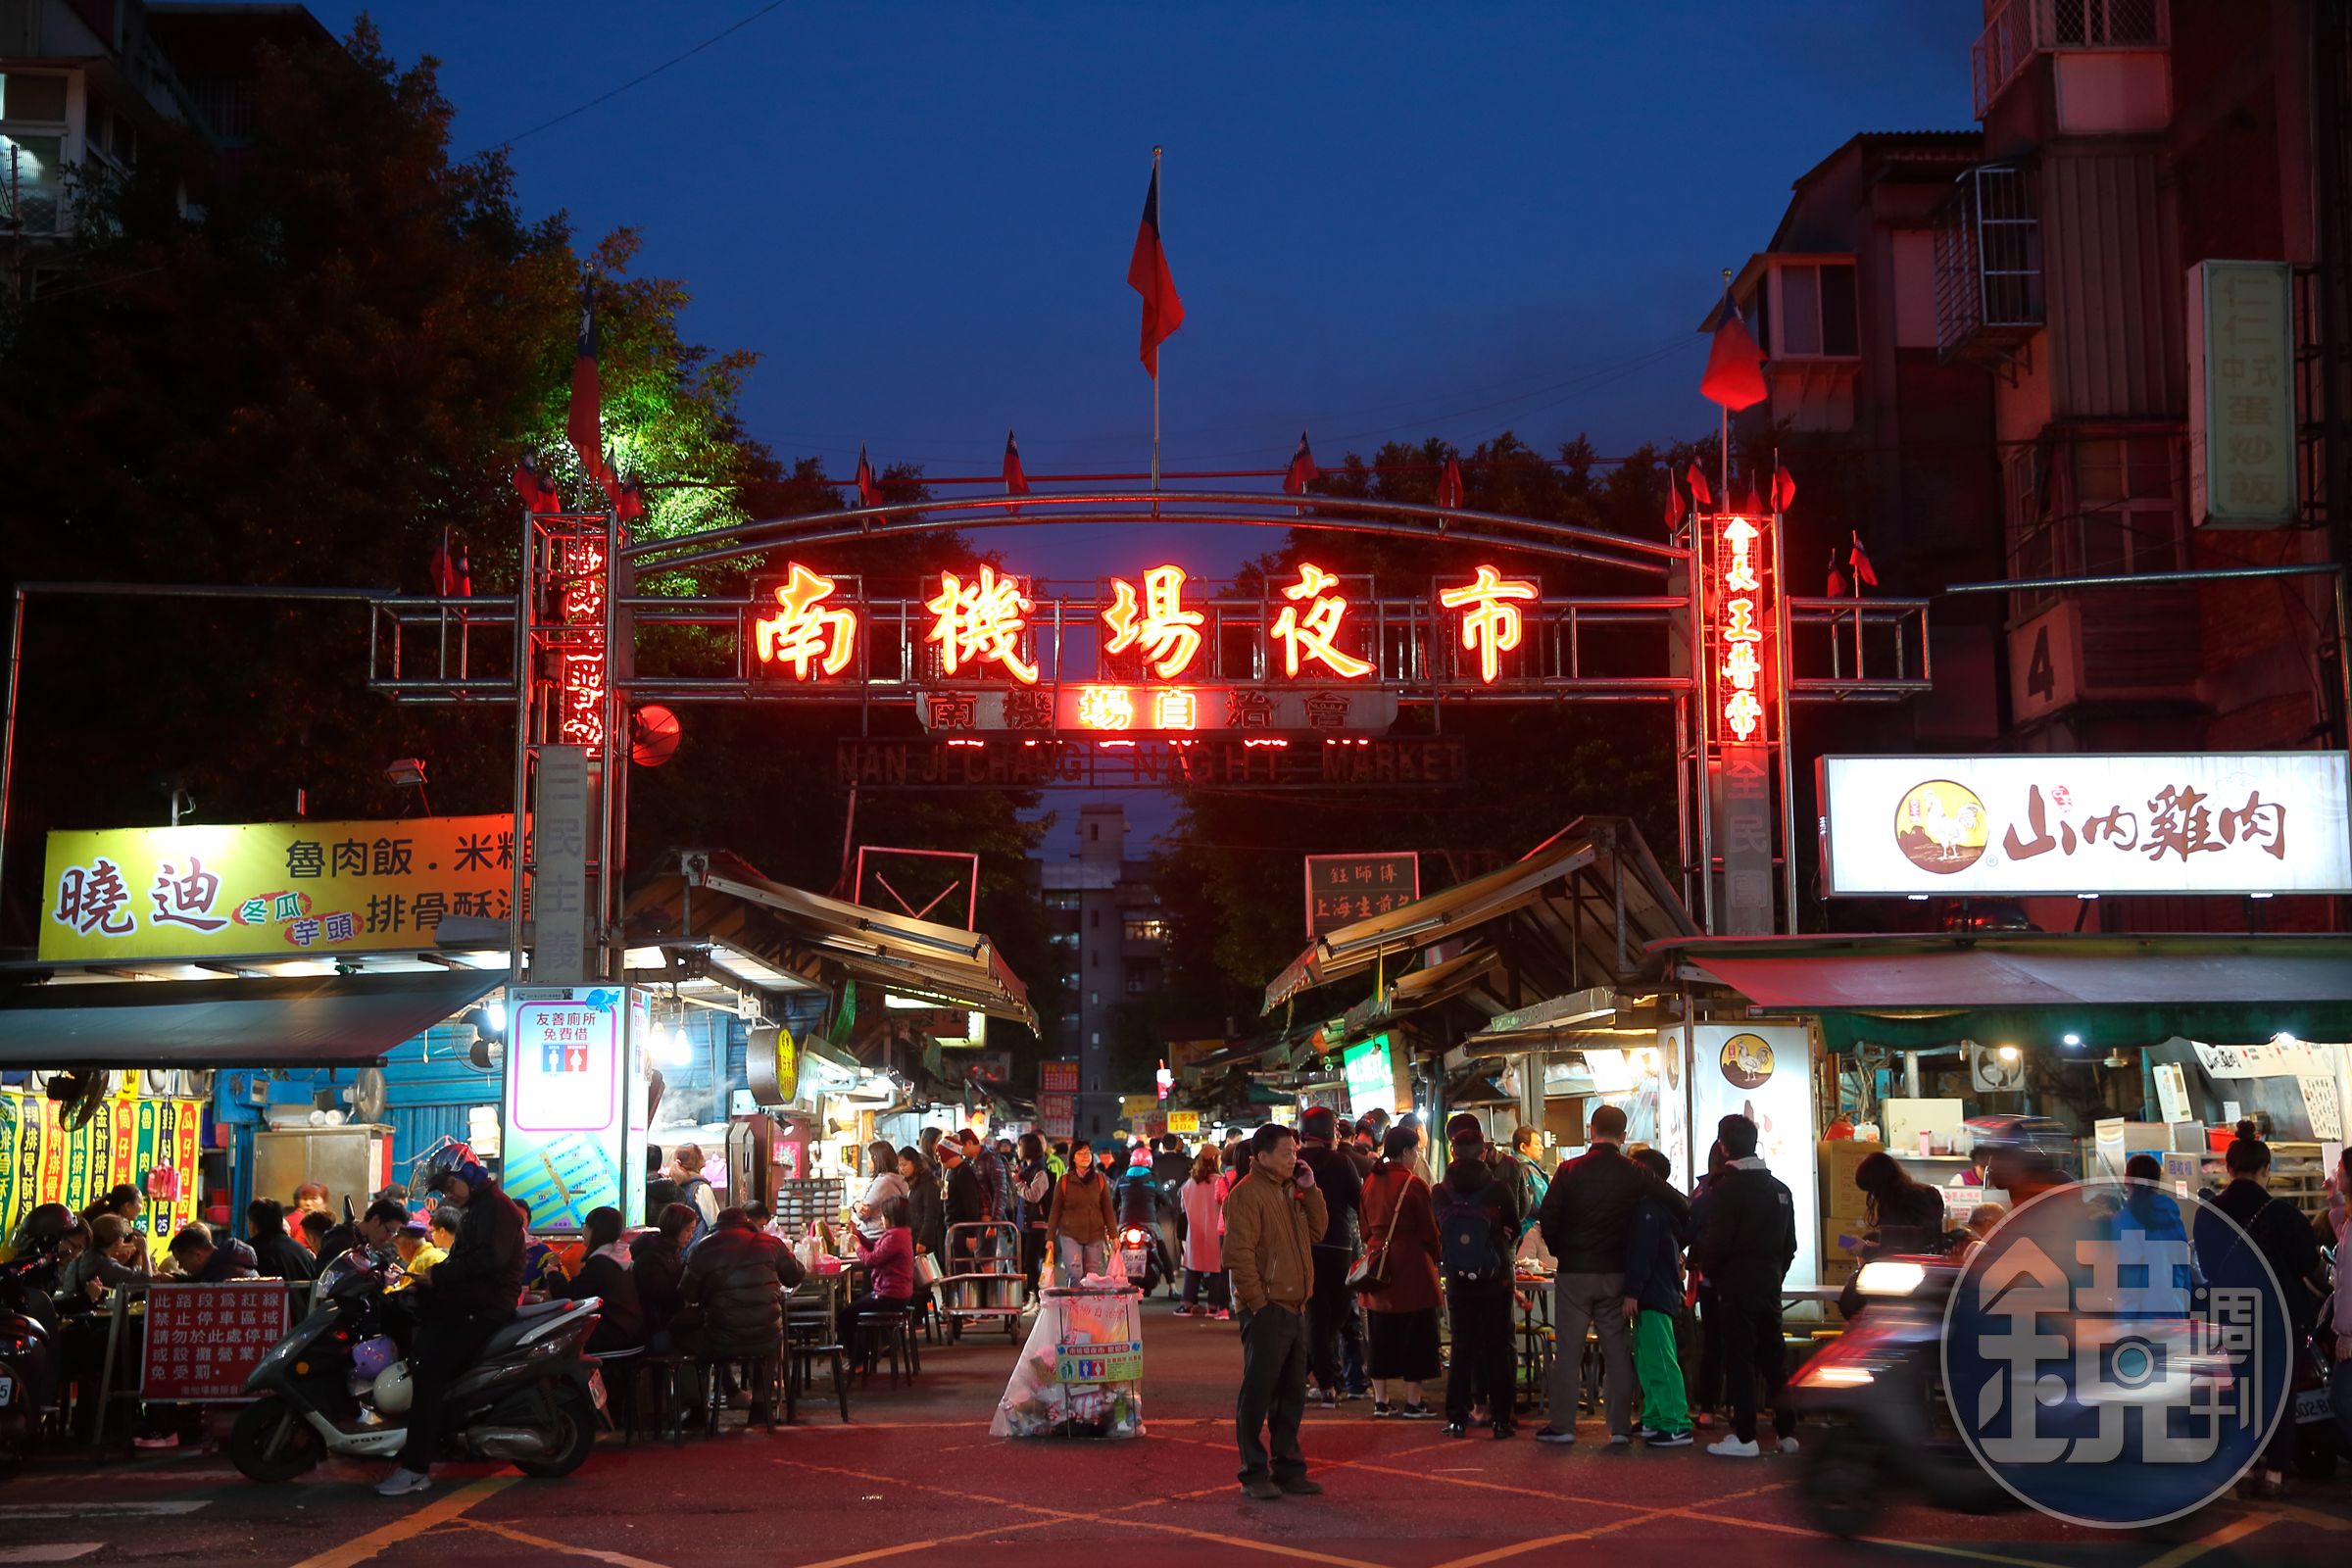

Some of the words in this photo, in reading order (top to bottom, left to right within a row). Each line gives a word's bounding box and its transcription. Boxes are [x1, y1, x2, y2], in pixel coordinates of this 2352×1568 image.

[756, 561, 1540, 685] 南機場夜市
[928, 689, 1351, 731] 南機場自治會
[1322, 742, 1467, 783] MARKET
[539, 761, 584, 969] 三民主義
[57, 857, 227, 935] 曉迪
[241, 891, 302, 925] 冬瓜
[293, 913, 355, 948] 芋頭
[536, 1011, 597, 1026] 友善廁所
[544, 1027, 589, 1042] 免費借
[92, 1105, 109, 1201] 金針排骨
[157, 1219, 169, 1233] 25
[154, 1310, 279, 1326] 禁止停車區域
[153, 1329, 281, 1345] 請勿於此處停車
